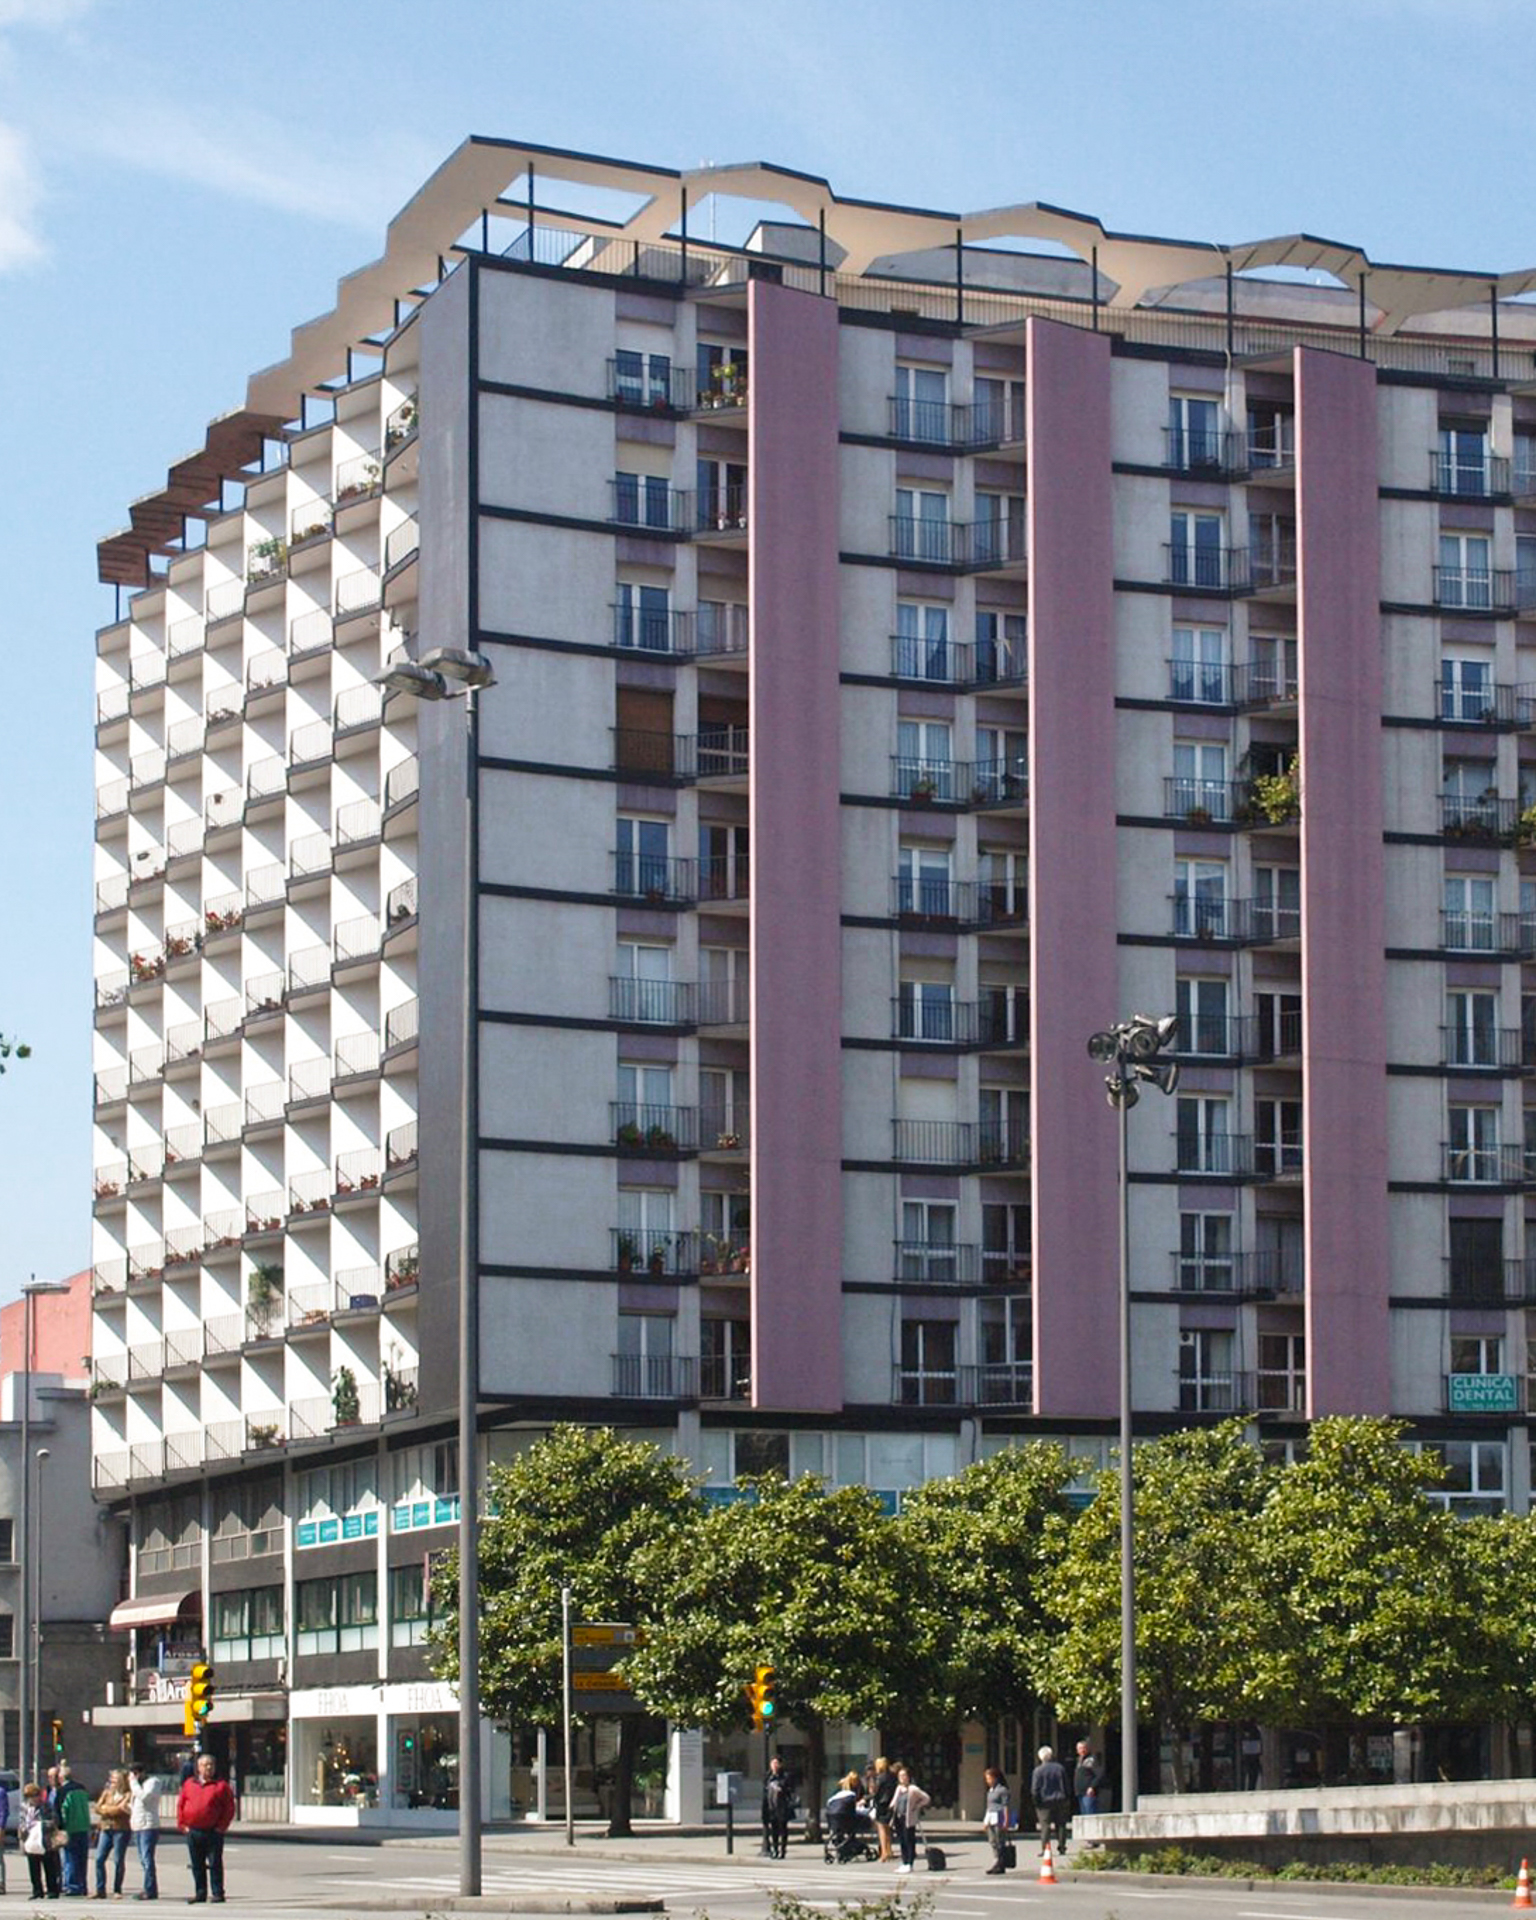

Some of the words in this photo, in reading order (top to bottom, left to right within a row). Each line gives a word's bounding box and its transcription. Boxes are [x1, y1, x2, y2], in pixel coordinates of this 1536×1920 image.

[1453, 1377, 1512, 1388] CLINICA
[1453, 1389, 1512, 1401] DENTAL
[318, 1691, 350, 1714] FHOA
[408, 1687, 443, 1710] FHOA
